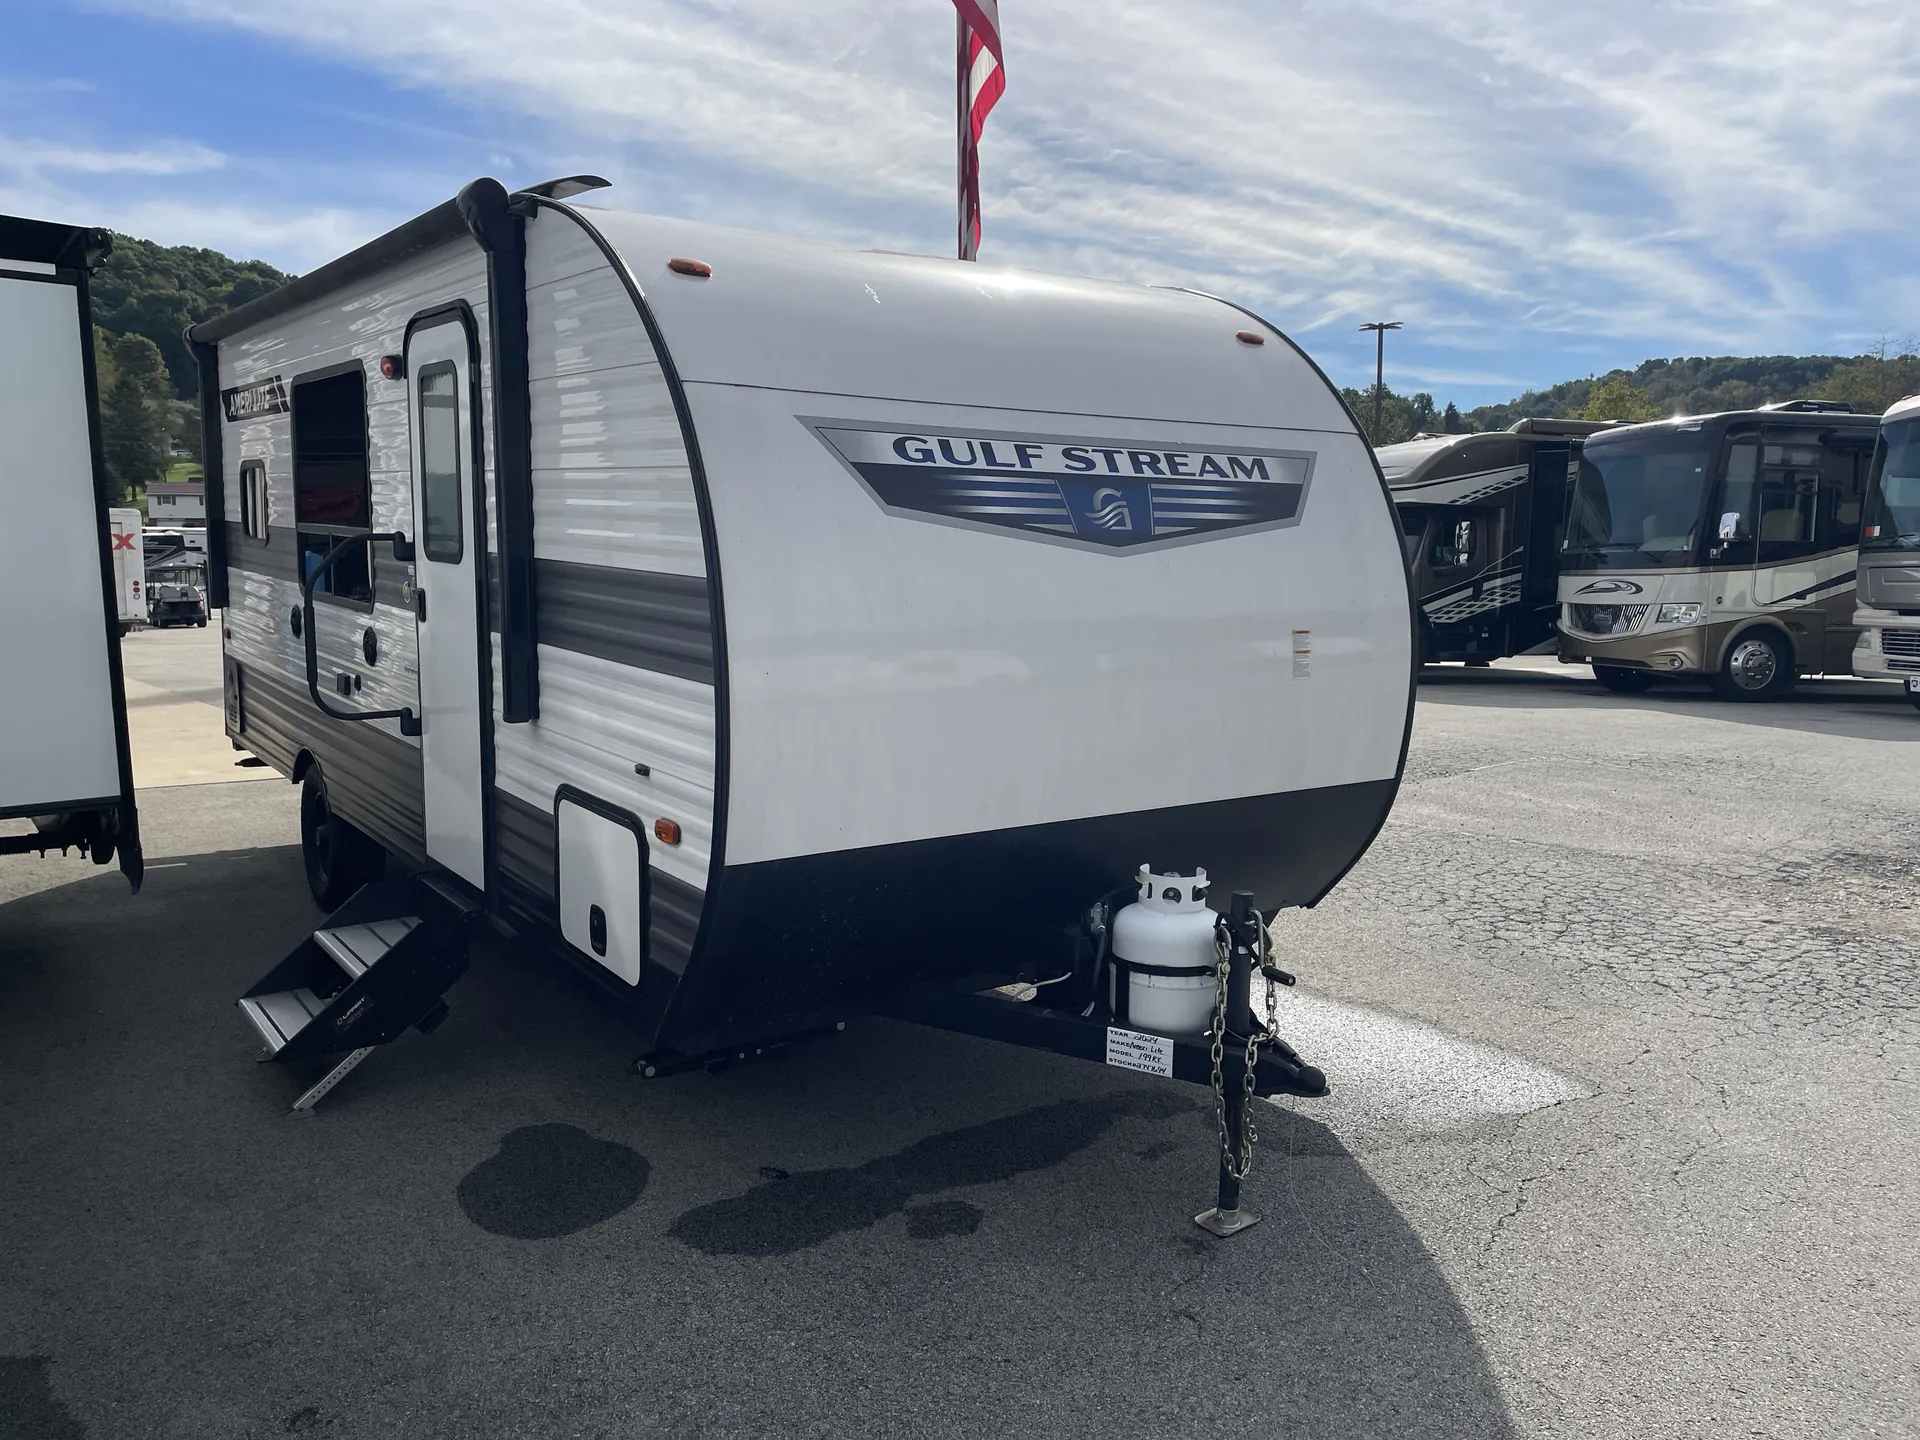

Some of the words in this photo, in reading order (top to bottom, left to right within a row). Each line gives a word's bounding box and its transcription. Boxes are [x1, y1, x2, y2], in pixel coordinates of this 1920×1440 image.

[892, 436, 1044, 468] GULF
[1060, 446, 1271, 480] STREAM
[1110, 1039, 1129, 1047] MAKE
[1134, 1033, 1158, 1044] 2024
[1109, 1048, 1133, 1057] MODEL
